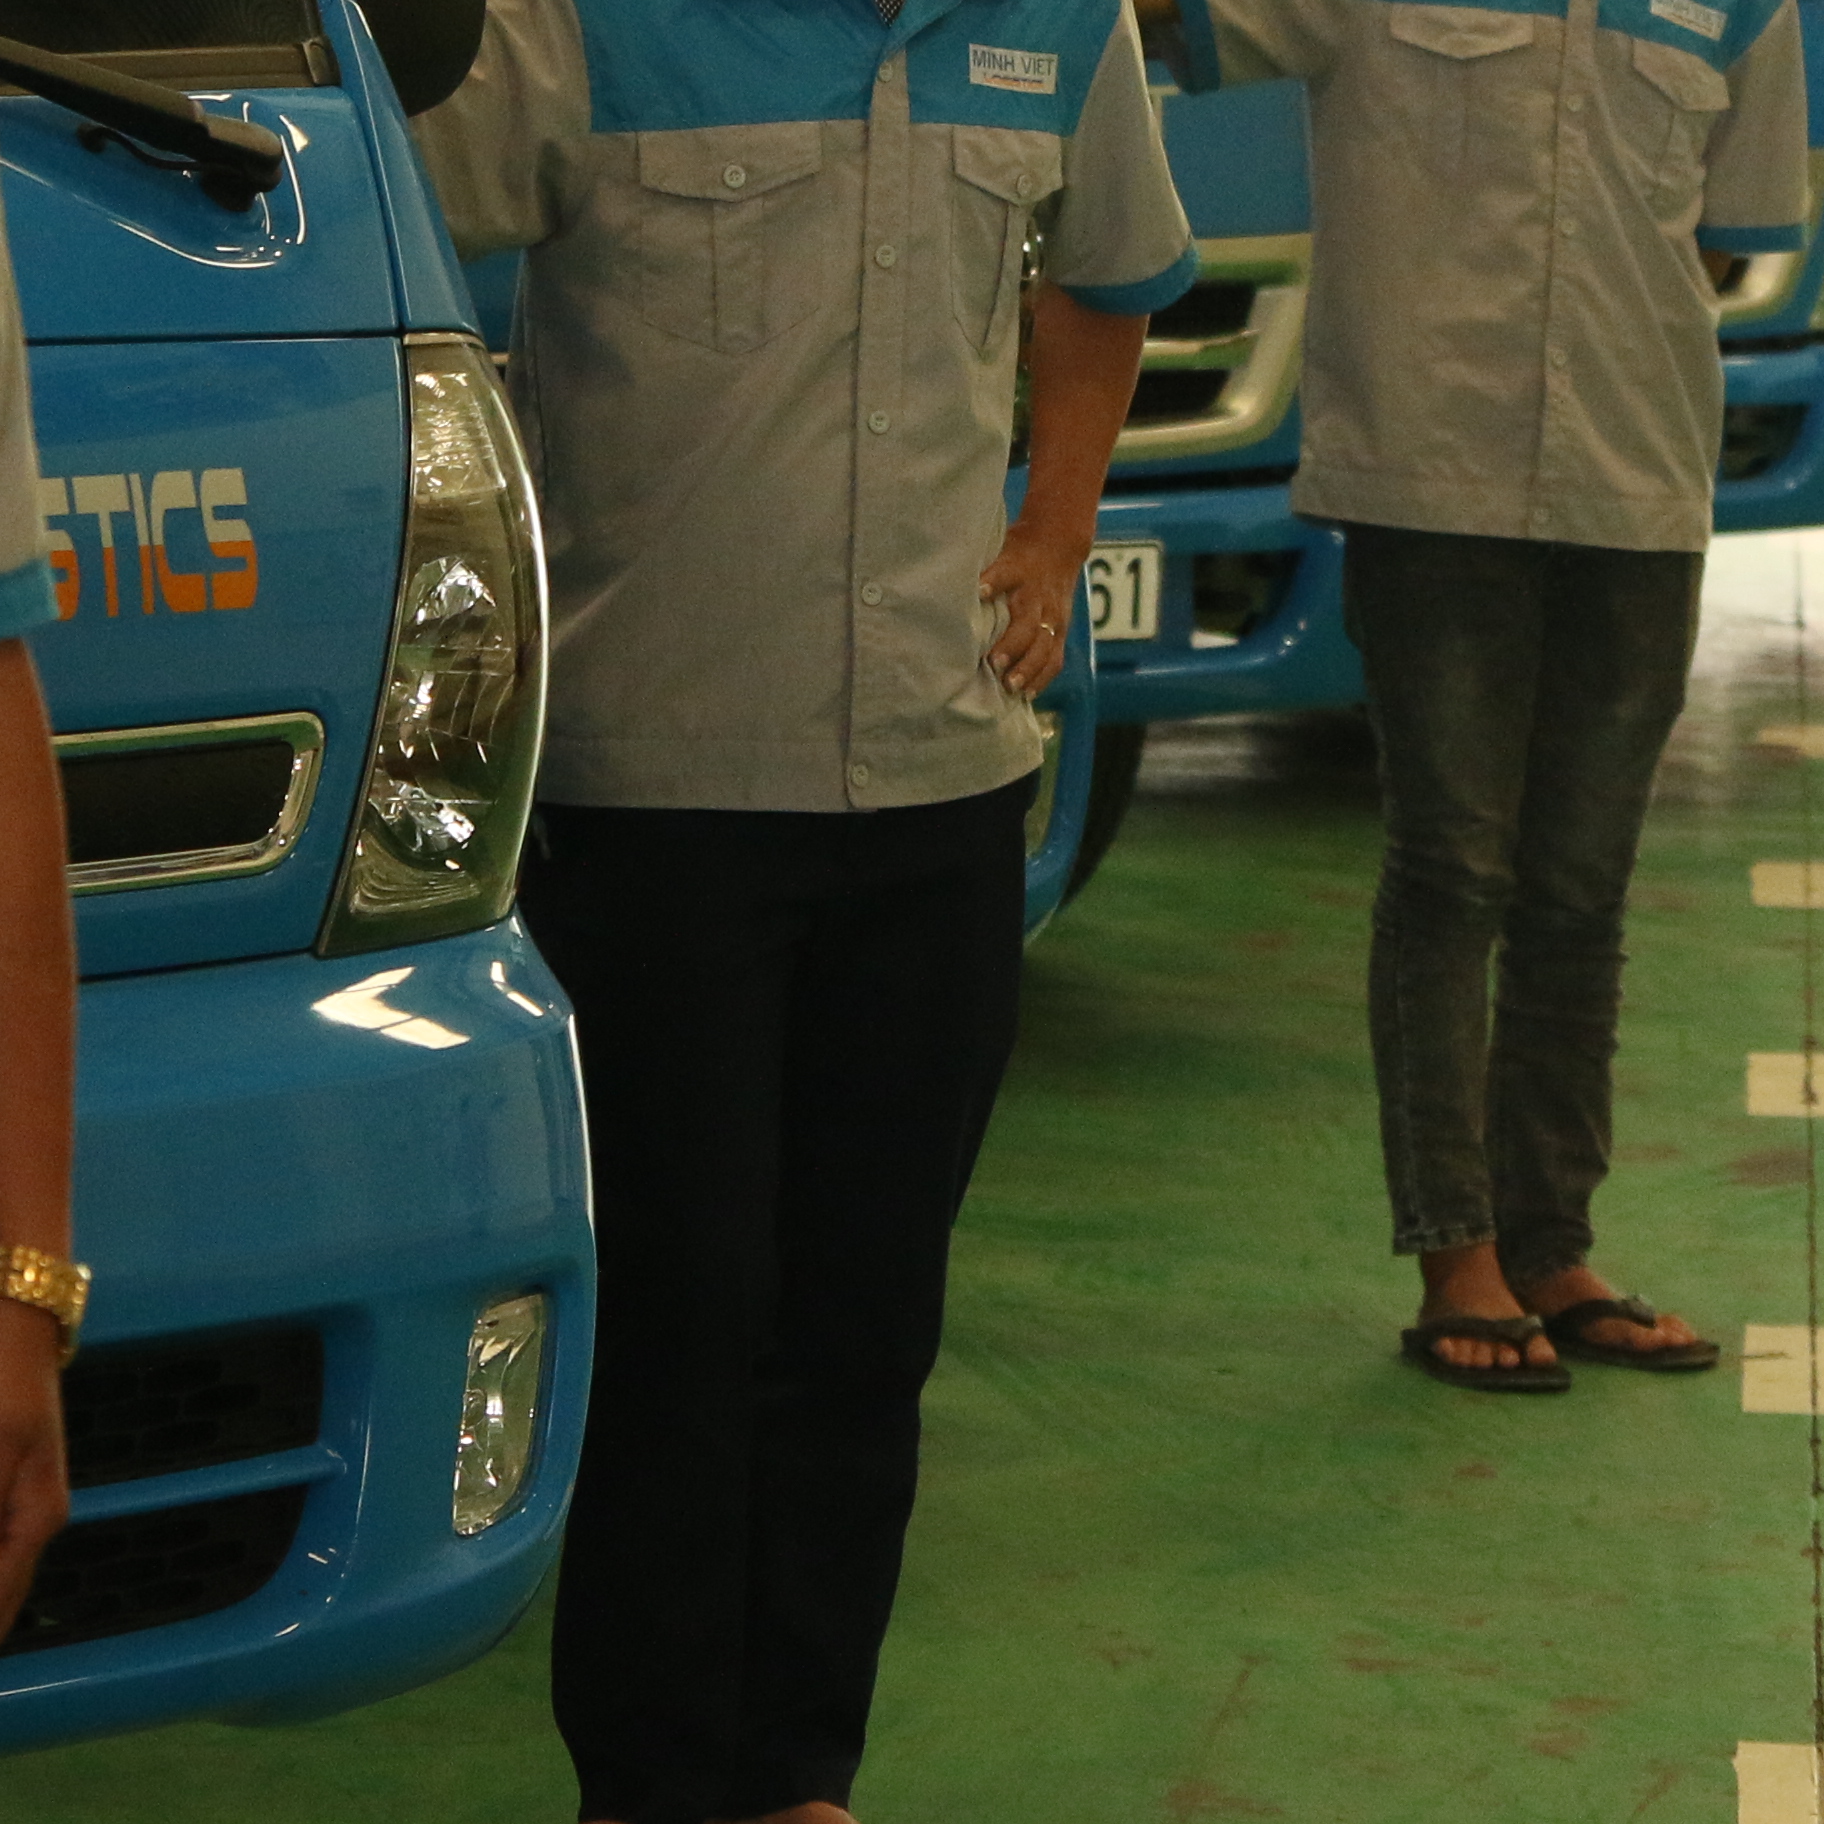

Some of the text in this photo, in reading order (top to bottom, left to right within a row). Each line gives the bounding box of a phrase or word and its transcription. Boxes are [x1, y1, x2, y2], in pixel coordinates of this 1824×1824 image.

[972, 50, 1055, 76] MINH VIET
[36, 468, 259, 622] STICS
